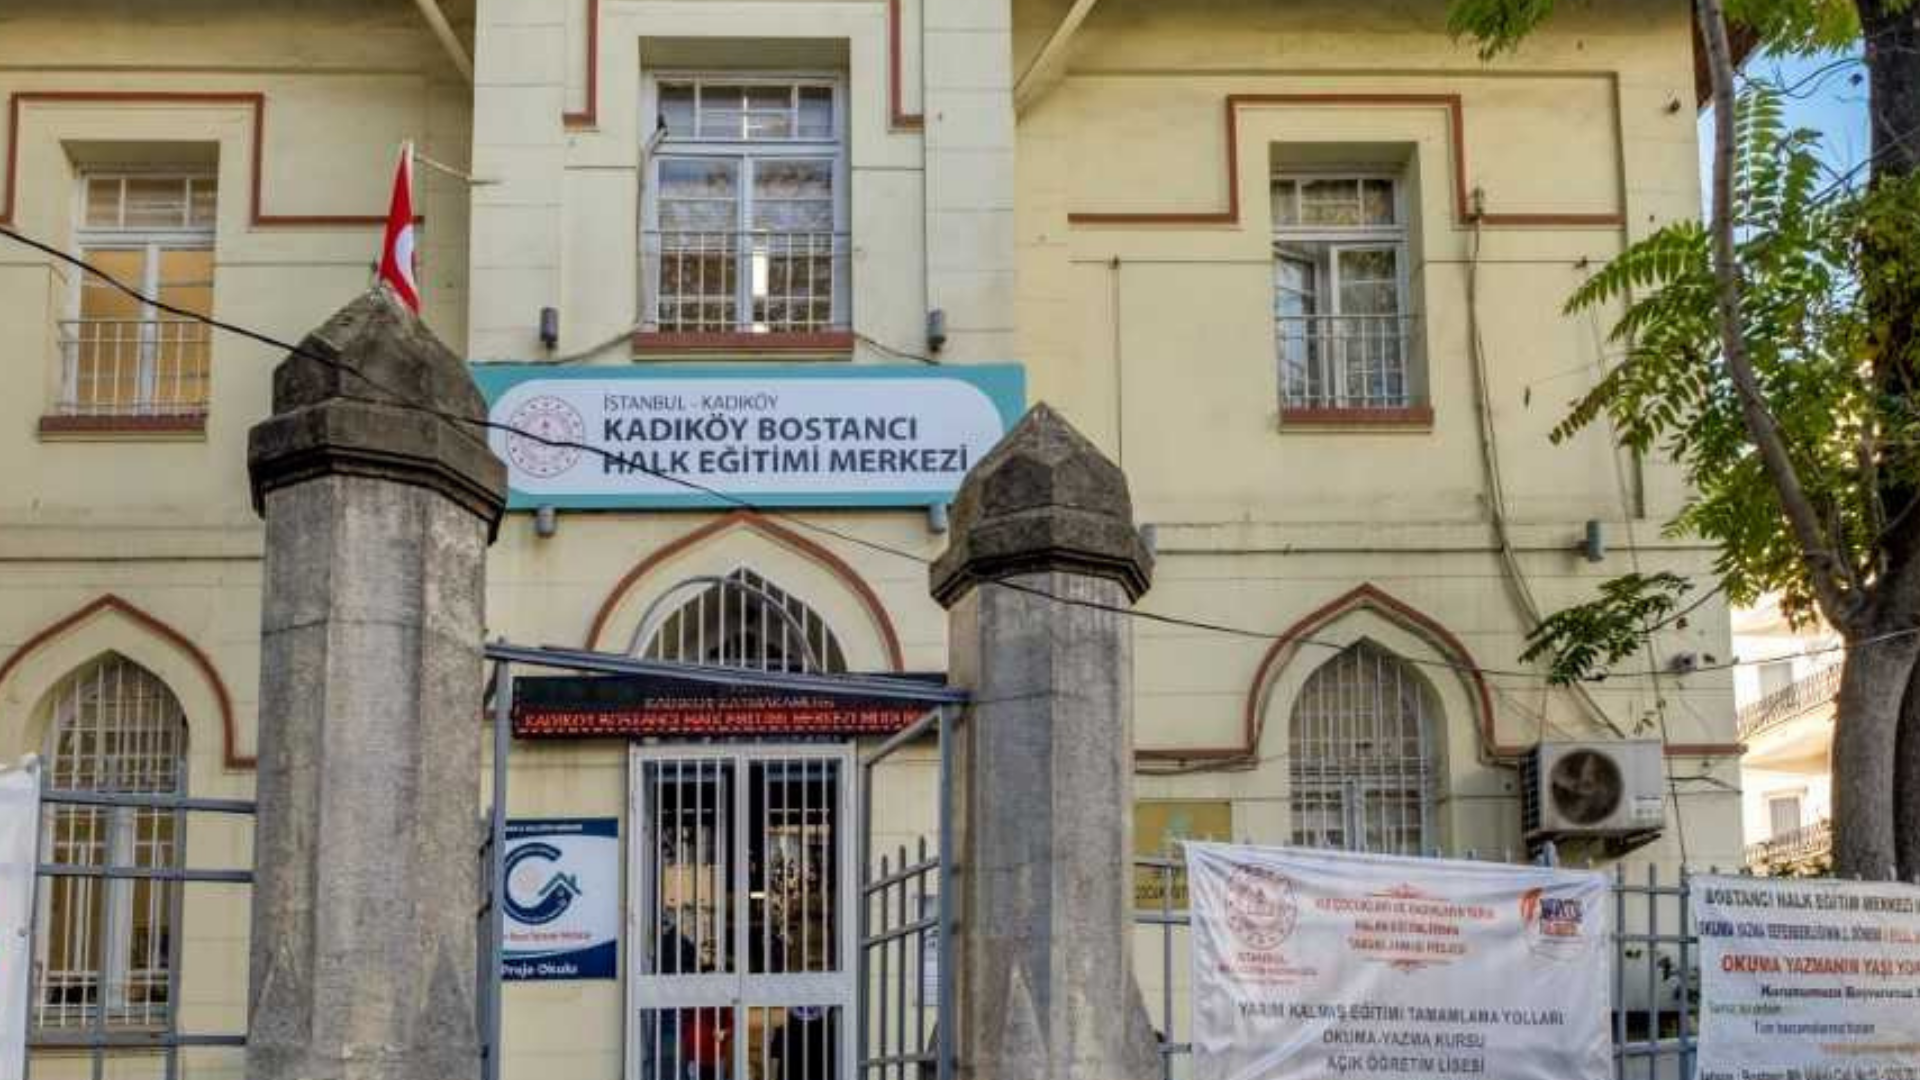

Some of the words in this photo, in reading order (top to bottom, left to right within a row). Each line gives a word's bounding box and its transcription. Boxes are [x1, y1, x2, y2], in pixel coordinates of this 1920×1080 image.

[604, 394, 685, 411] İSTANBUL
[701, 392, 778, 411] KADIKÖY
[604, 413, 748, 441] KADIKÖY
[759, 417, 917, 441] BOSTANCI
[604, 450, 690, 475] HALK
[700, 444, 819, 474] EĞİTİMİ
[830, 444, 968, 473] MERKEZİ
[1705, 888, 1773, 908] BOSTANCI
[1777, 891, 1812, 909] HALK
[1721, 954, 1780, 972] OKUMA
[1785, 956, 1859, 974] YAZMANIN
[1407, 1006, 1498, 1024] TAMAMLAMA
[1501, 1009, 1565, 1026] YOLLARI
[1435, 1032, 1484, 1048] KURSU
[1328, 1055, 1363, 1074] AÇIK
